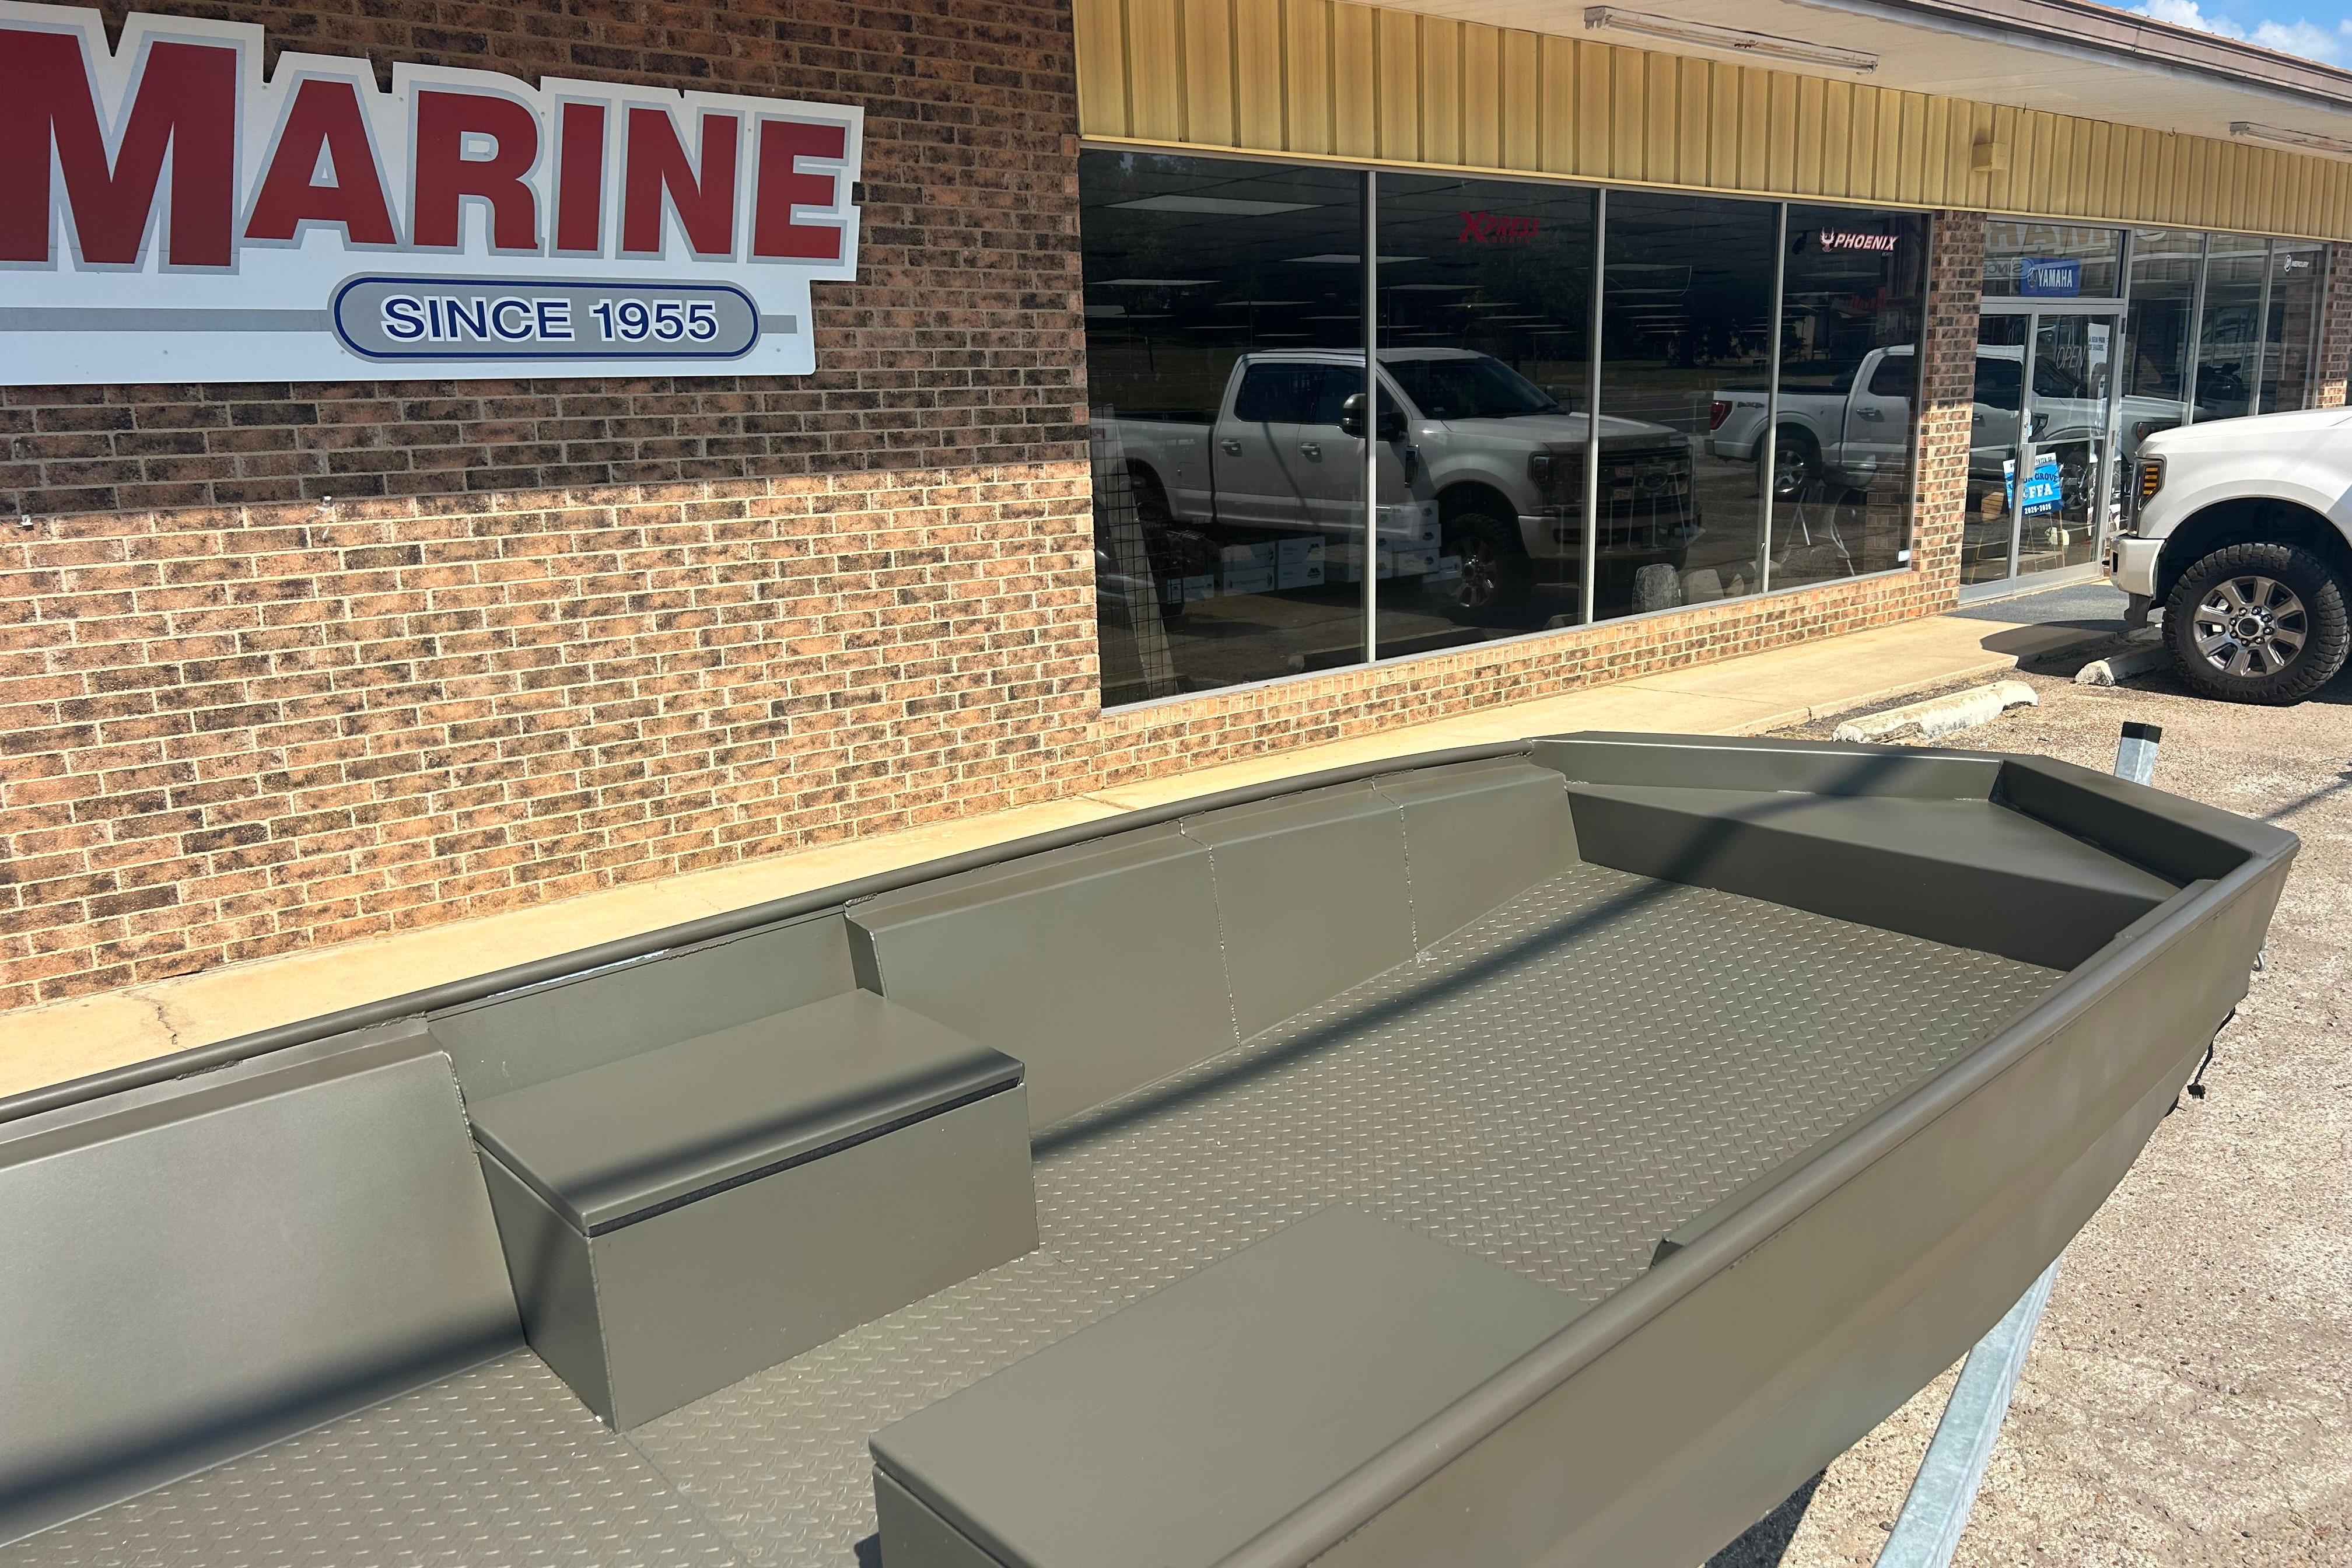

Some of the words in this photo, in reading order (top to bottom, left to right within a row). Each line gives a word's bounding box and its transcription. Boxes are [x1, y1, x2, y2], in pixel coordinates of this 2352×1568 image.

[0, 27, 848, 267] MARINE
[1458, 211, 1541, 242] XPRESS
[1833, 233, 1899, 251] PHOENIX
[2038, 269, 2073, 288] YAMAHA
[382, 295, 573, 342] SINCE
[589, 299, 718, 342] 1955
[2056, 345, 2087, 369] OPEN
[2035, 473, 2058, 483] GROVE
[2028, 483, 2053, 499] FFA
